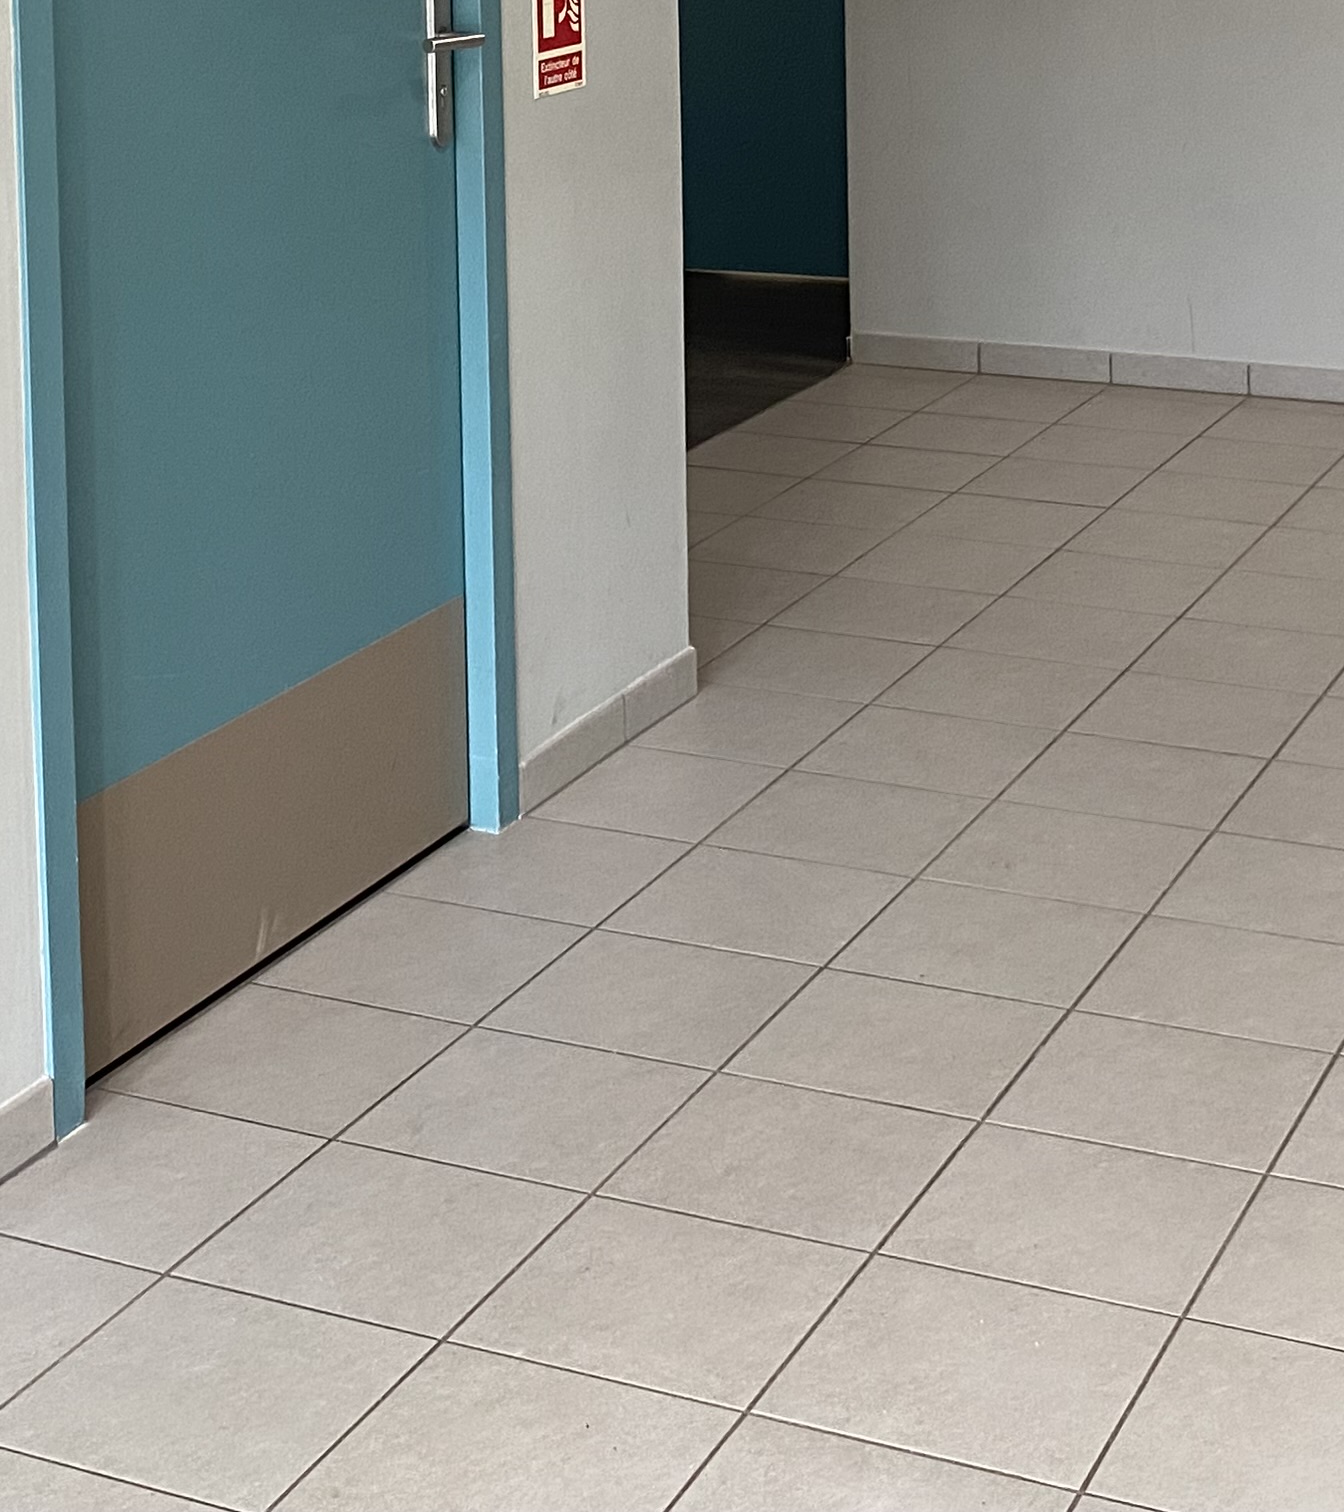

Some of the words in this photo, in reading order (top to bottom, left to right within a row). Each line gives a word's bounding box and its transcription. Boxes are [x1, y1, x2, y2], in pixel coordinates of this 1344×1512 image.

[541, 58, 570, 73] Extincteur
[571, 55, 580, 65] de
[543, 73, 563, 86] l'autre
[563, 66, 578, 81] côté
